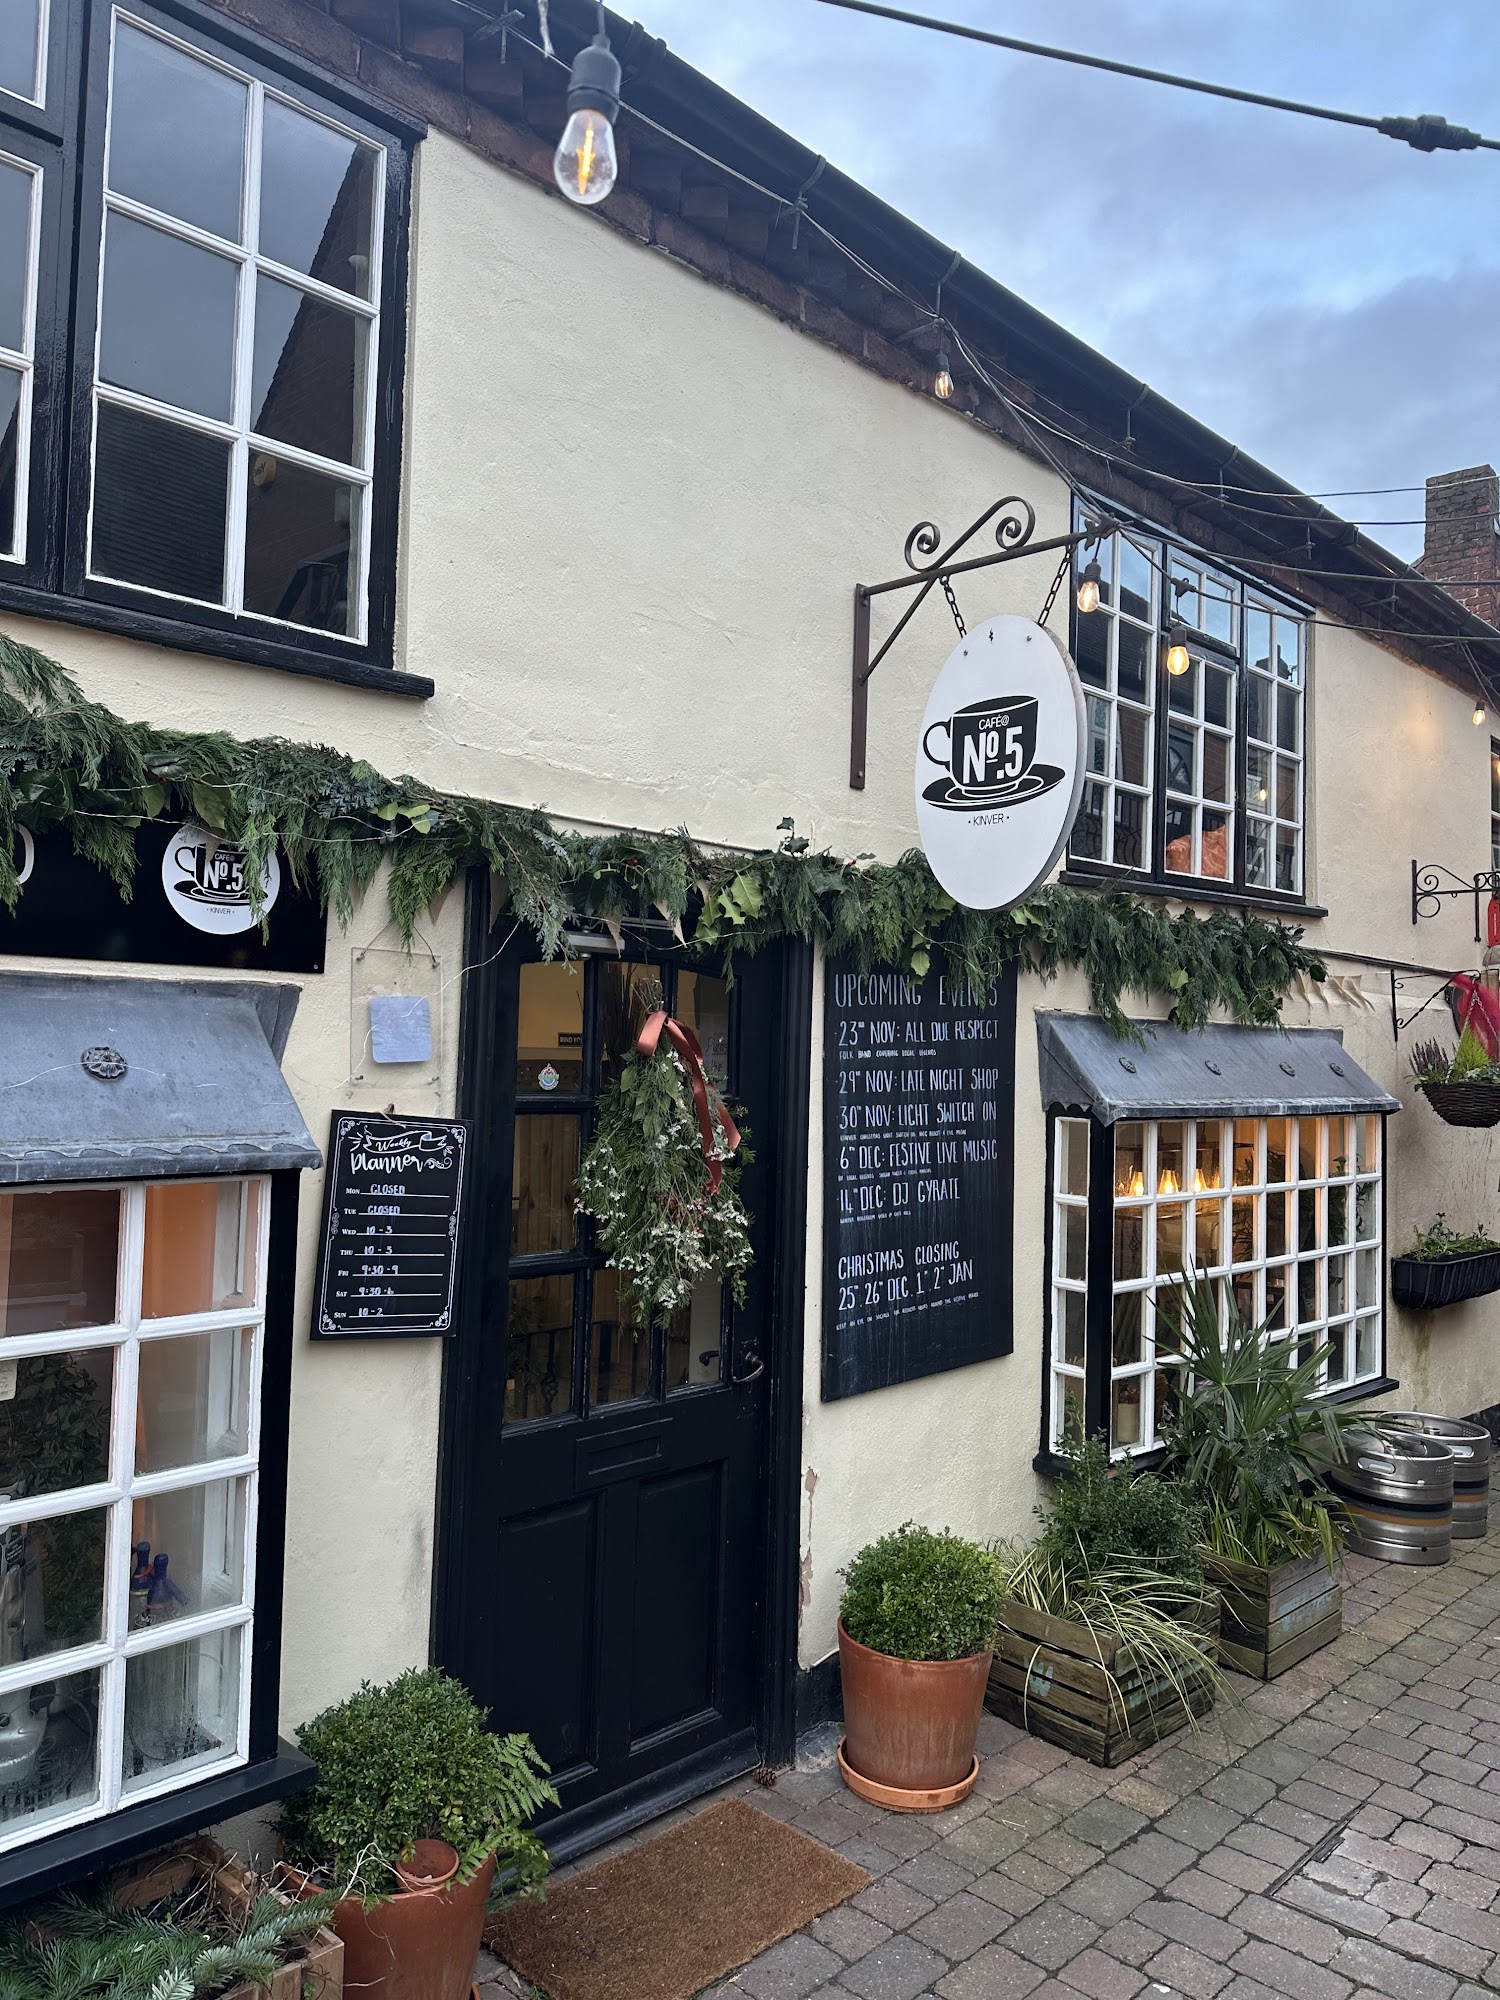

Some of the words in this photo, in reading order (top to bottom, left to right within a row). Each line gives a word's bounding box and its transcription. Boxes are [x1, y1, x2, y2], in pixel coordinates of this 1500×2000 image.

[973, 813, 1005, 826] KINVER
[210, 907, 232, 915] KINVER
[835, 974, 921, 1007] UPCOMING
[939, 975, 998, 1007] EVENS
[870, 1021, 900, 1044] NOV:
[905, 1021, 926, 1042] ALL
[931, 1021, 950, 1041] DUE
[955, 1020, 998, 1040] RESPECT
[840, 1051, 854, 1060] FOLK
[858, 1050, 871, 1059] BAND
[876, 1050, 898, 1058] COVERING
[902, 1049, 915, 1057] LOCAL
[865, 1070, 897, 1092] NOV:
[901, 1070, 925, 1091] LATE
[930, 1068, 963, 1090] NIGHT
[970, 1068, 998, 1089] SHOP
[865, 1105, 895, 1127] NOV:
[898, 1104, 928, 1126] LIGHT
[937, 1102, 975, 1123] SWITCH
[983, 1101, 996, 1121] ON
[376, 1138, 411, 1151] Weekly
[859, 1146, 885, 1168] DEC:
[889, 1142, 931, 1167] FESTIVE
[937, 1141, 958, 1163] LIVE
[963, 1139, 998, 1162] MUSIC
[350, 1152, 423, 1175] planner
[370, 1183, 406, 1195] CLOSED
[860, 1185, 886, 1210] DEC:
[893, 1182, 908, 1206] DJ
[918, 1178, 960, 1203] GYRATE
[367, 1205, 401, 1215] CLOSED
[367, 1226, 375, 1235] 10
[385, 1226, 393, 1235] 3
[364, 1246, 374, 1255] 10
[385, 1246, 393, 1255] 3
[838, 1248, 904, 1280] CHRISTMAS
[915, 1241, 959, 1265] CLOSING
[948, 1259, 973, 1285] JAN
[358, 1308, 368, 1317] 10
[376, 1308, 384, 1316] 2
